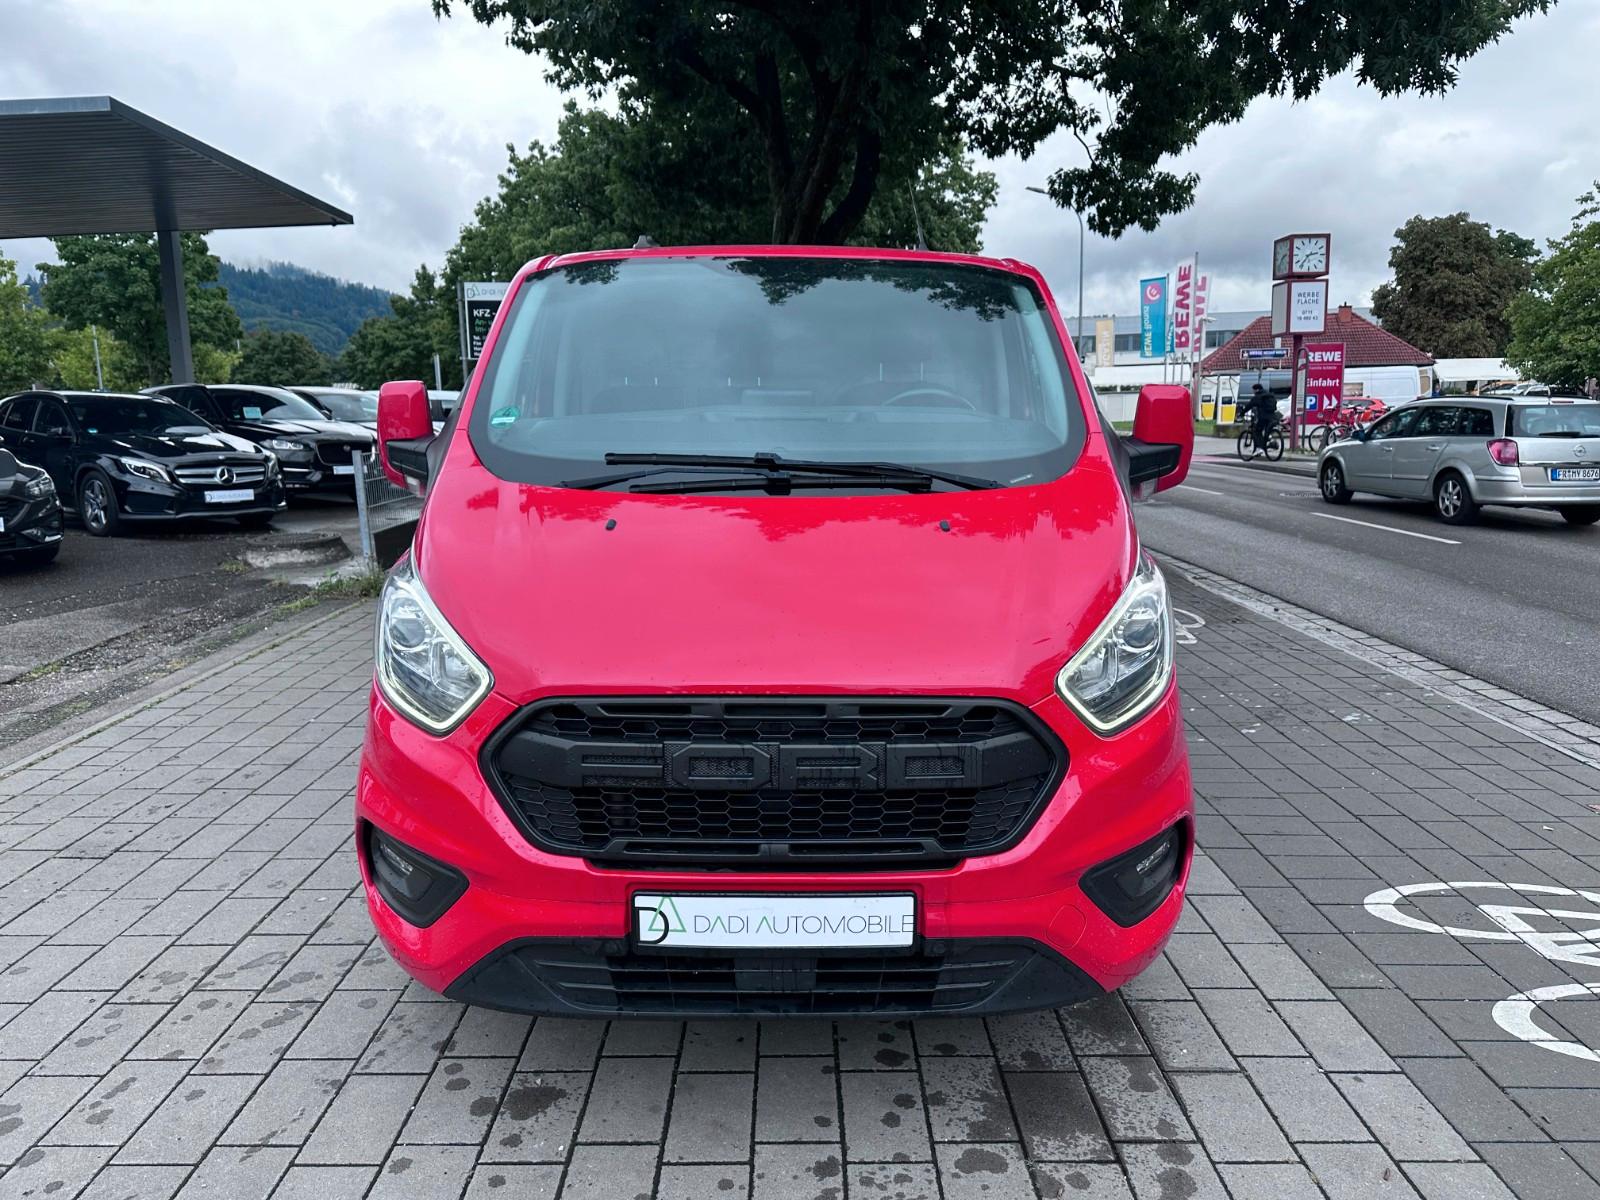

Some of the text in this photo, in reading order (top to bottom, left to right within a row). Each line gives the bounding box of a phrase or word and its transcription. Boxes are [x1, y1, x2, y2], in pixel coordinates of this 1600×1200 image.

[473, 309, 491, 317] KFZ
[1308, 351, 1341, 362] REWE
[566, 742, 983, 790] FORD
[694, 915, 749, 934] DADI
[755, 914, 915, 934] AUTOMOBILE
